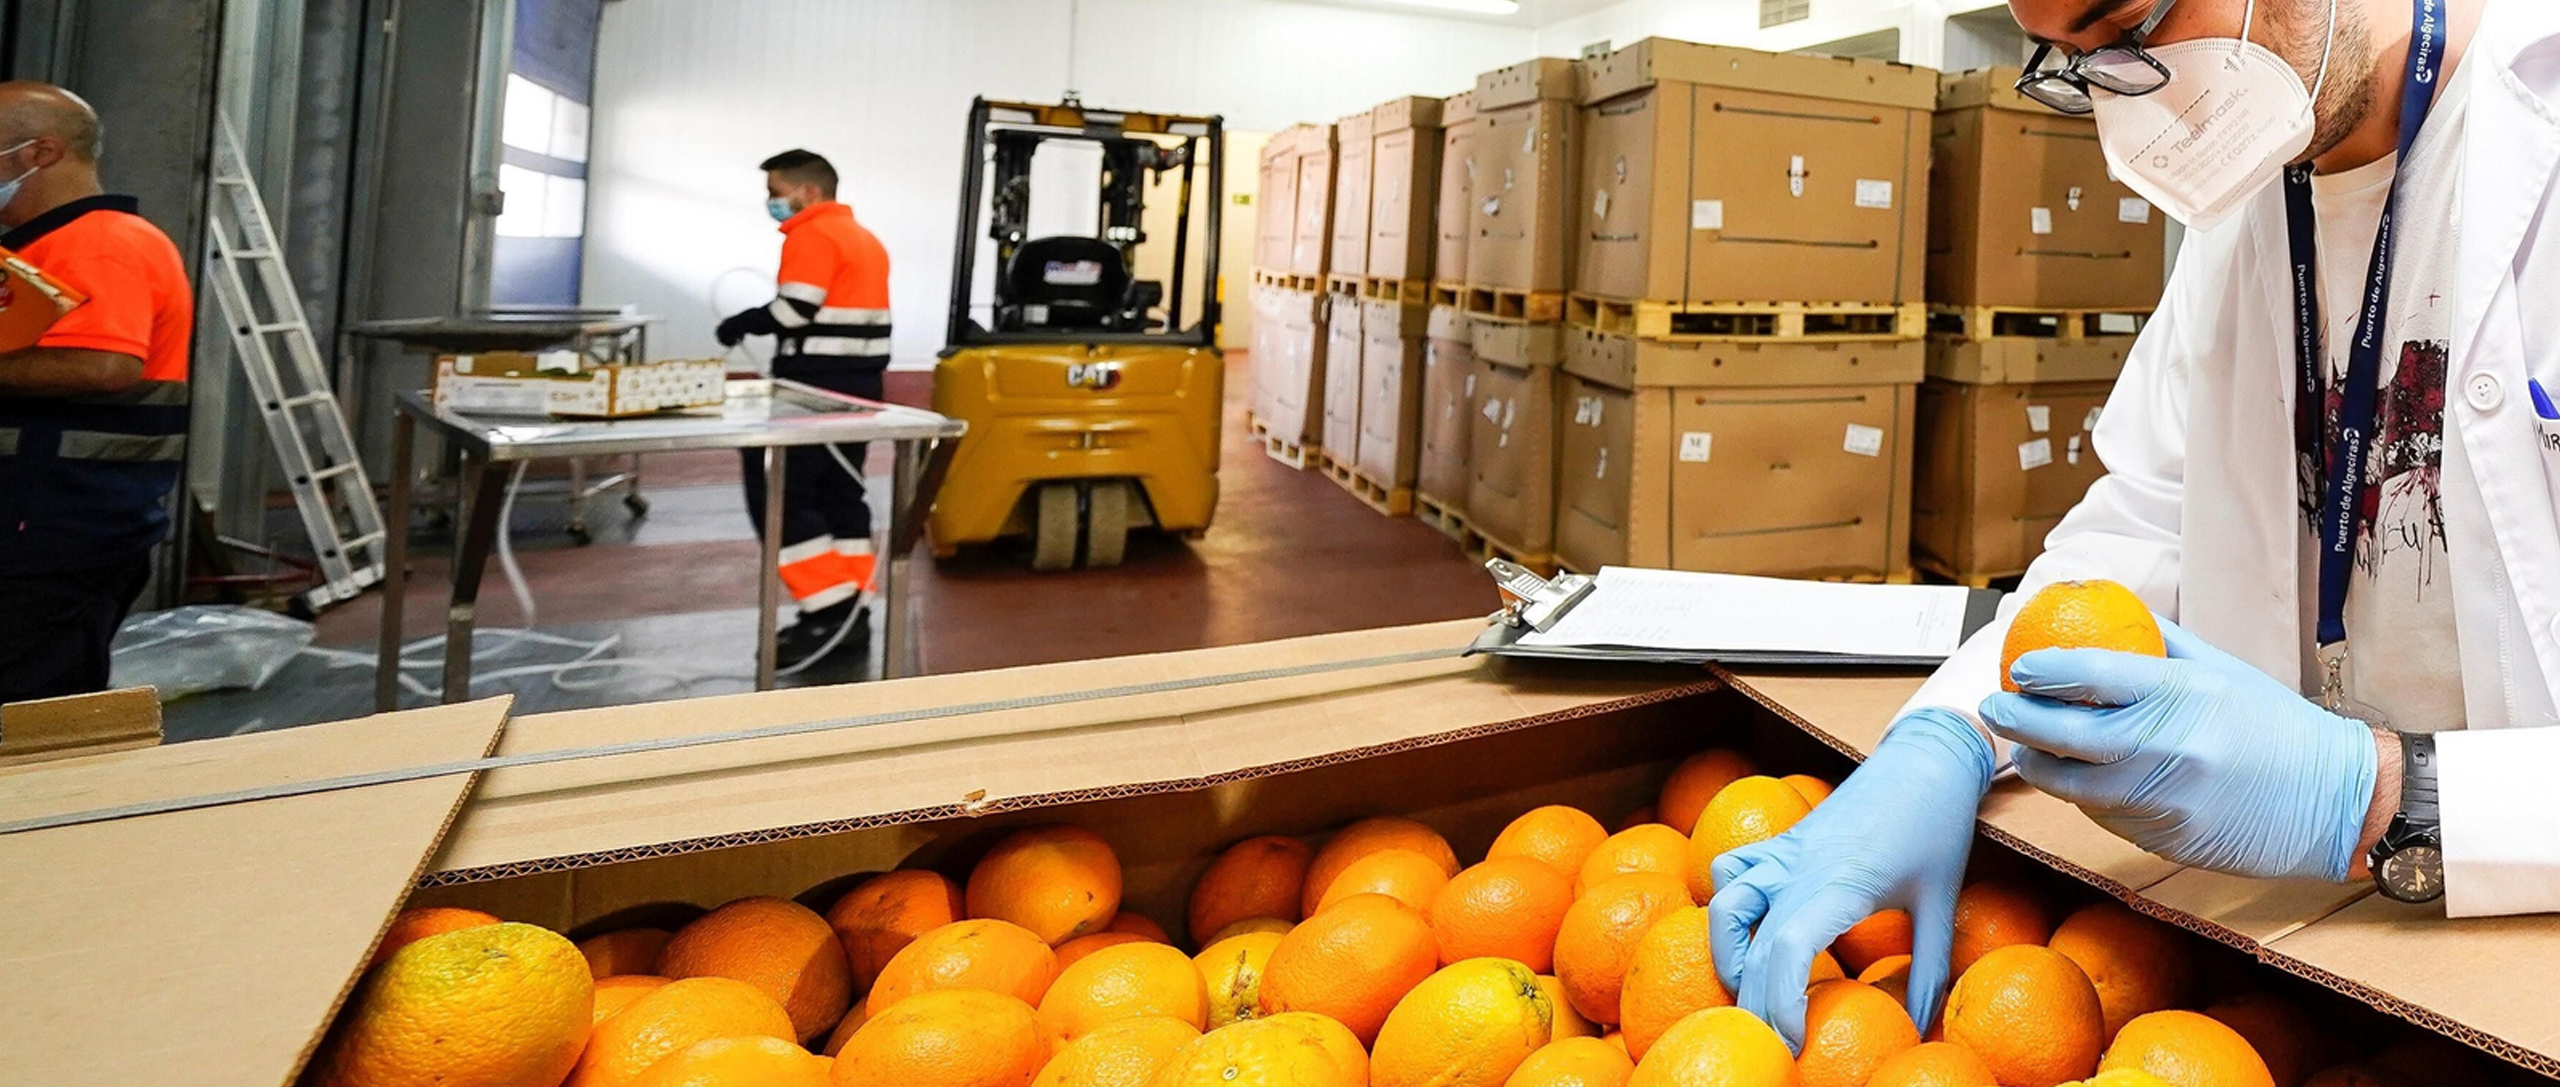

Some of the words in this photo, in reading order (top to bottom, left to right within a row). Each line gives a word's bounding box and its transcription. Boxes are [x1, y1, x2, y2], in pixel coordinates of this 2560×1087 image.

[2415, 13, 2435, 72] Algeciras
[2375, 225, 2390, 285] Algeciras
[2297, 264, 2307, 306] Puerto
[2371, 286, 2381, 303] de
[2301, 307, 2309, 324] de
[2361, 305, 2377, 348] Puerto
[1067, 362, 1112, 386] CAT
[2302, 325, 2312, 383] Algeciras
[2342, 438, 2360, 495] Algeciras
[2340, 495, 2352, 510] de
[2334, 511, 2349, 552] Puerto
